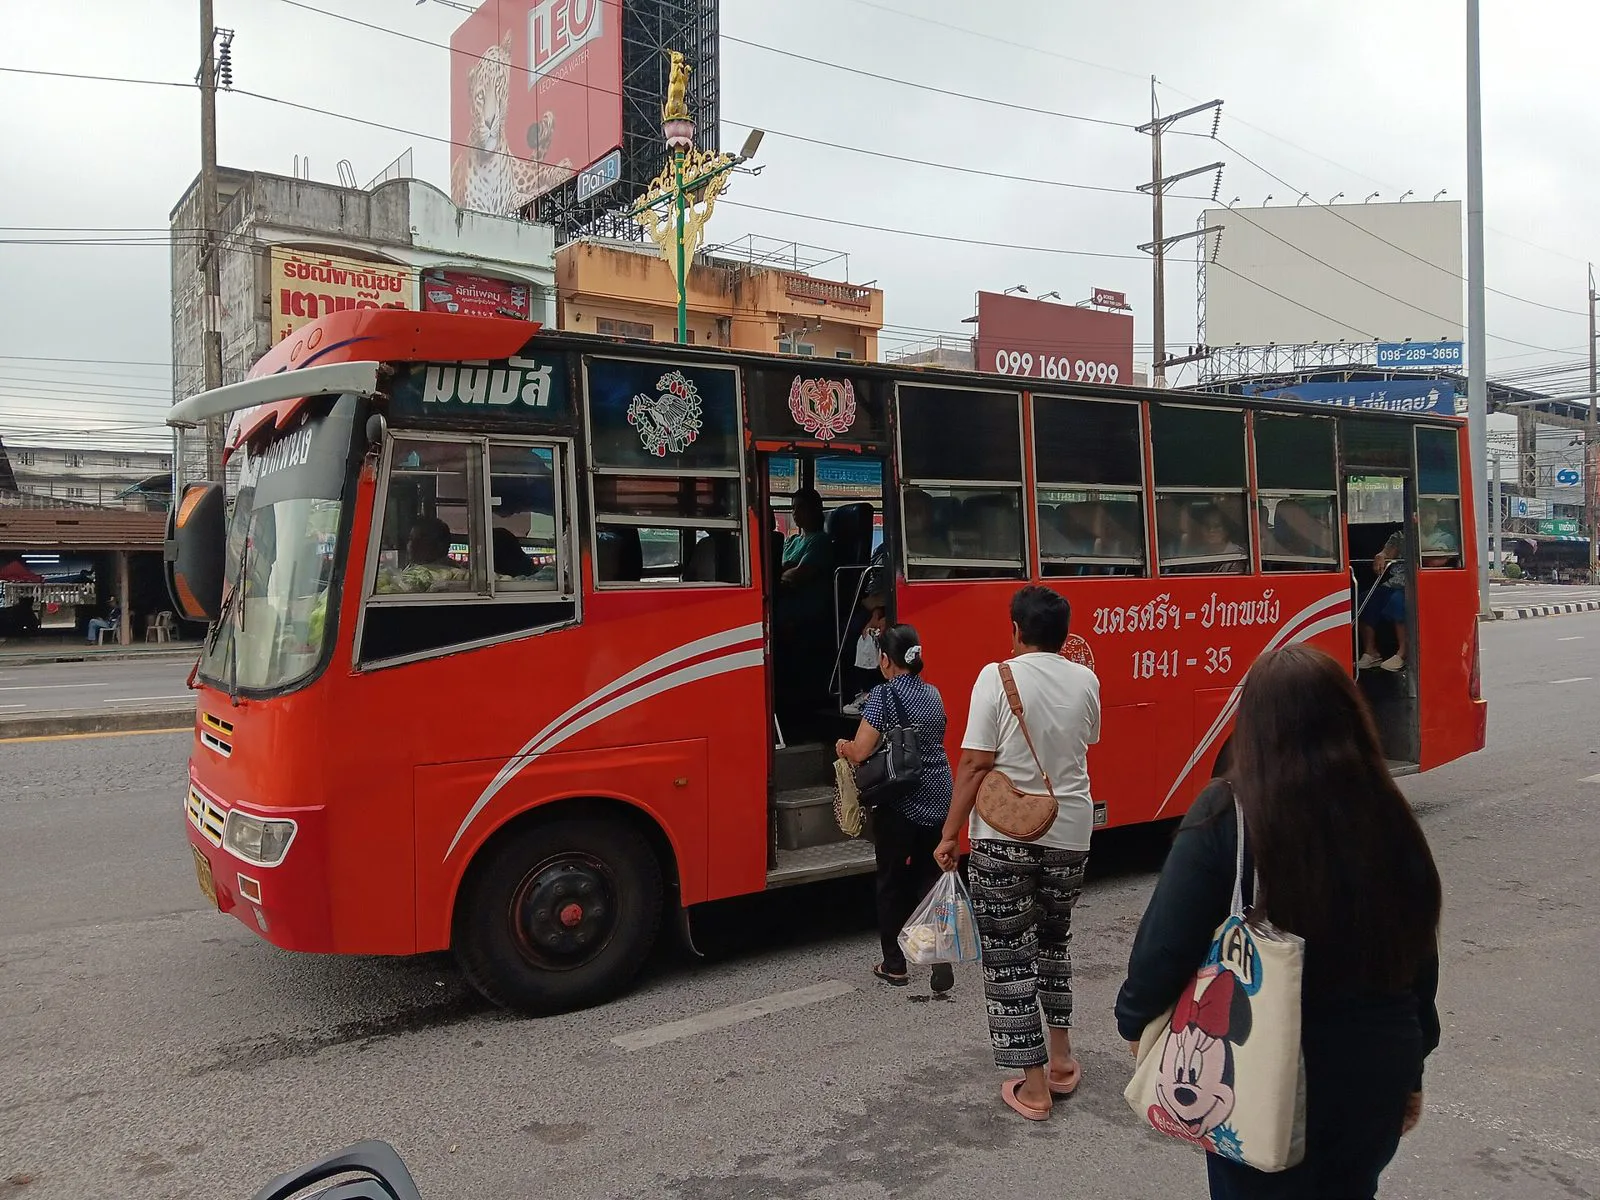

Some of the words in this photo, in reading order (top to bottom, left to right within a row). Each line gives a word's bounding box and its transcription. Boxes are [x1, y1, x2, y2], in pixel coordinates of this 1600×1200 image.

[533, 0, 597, 73] LEO
[568, 48, 590, 72] WATER
[995, 349, 1034, 376] 099
[1039, 354, 1071, 381] 160
[1074, 359, 1119, 384] 9999
[1380, 347, 1460, 361] 098-289-3656
[1092, 592, 1181, 635] นครศรีฯ
[1200, 588, 1281, 629] ปากพนัง
[1131, 649, 1180, 680] 1841
[1203, 646, 1232, 675] 35
